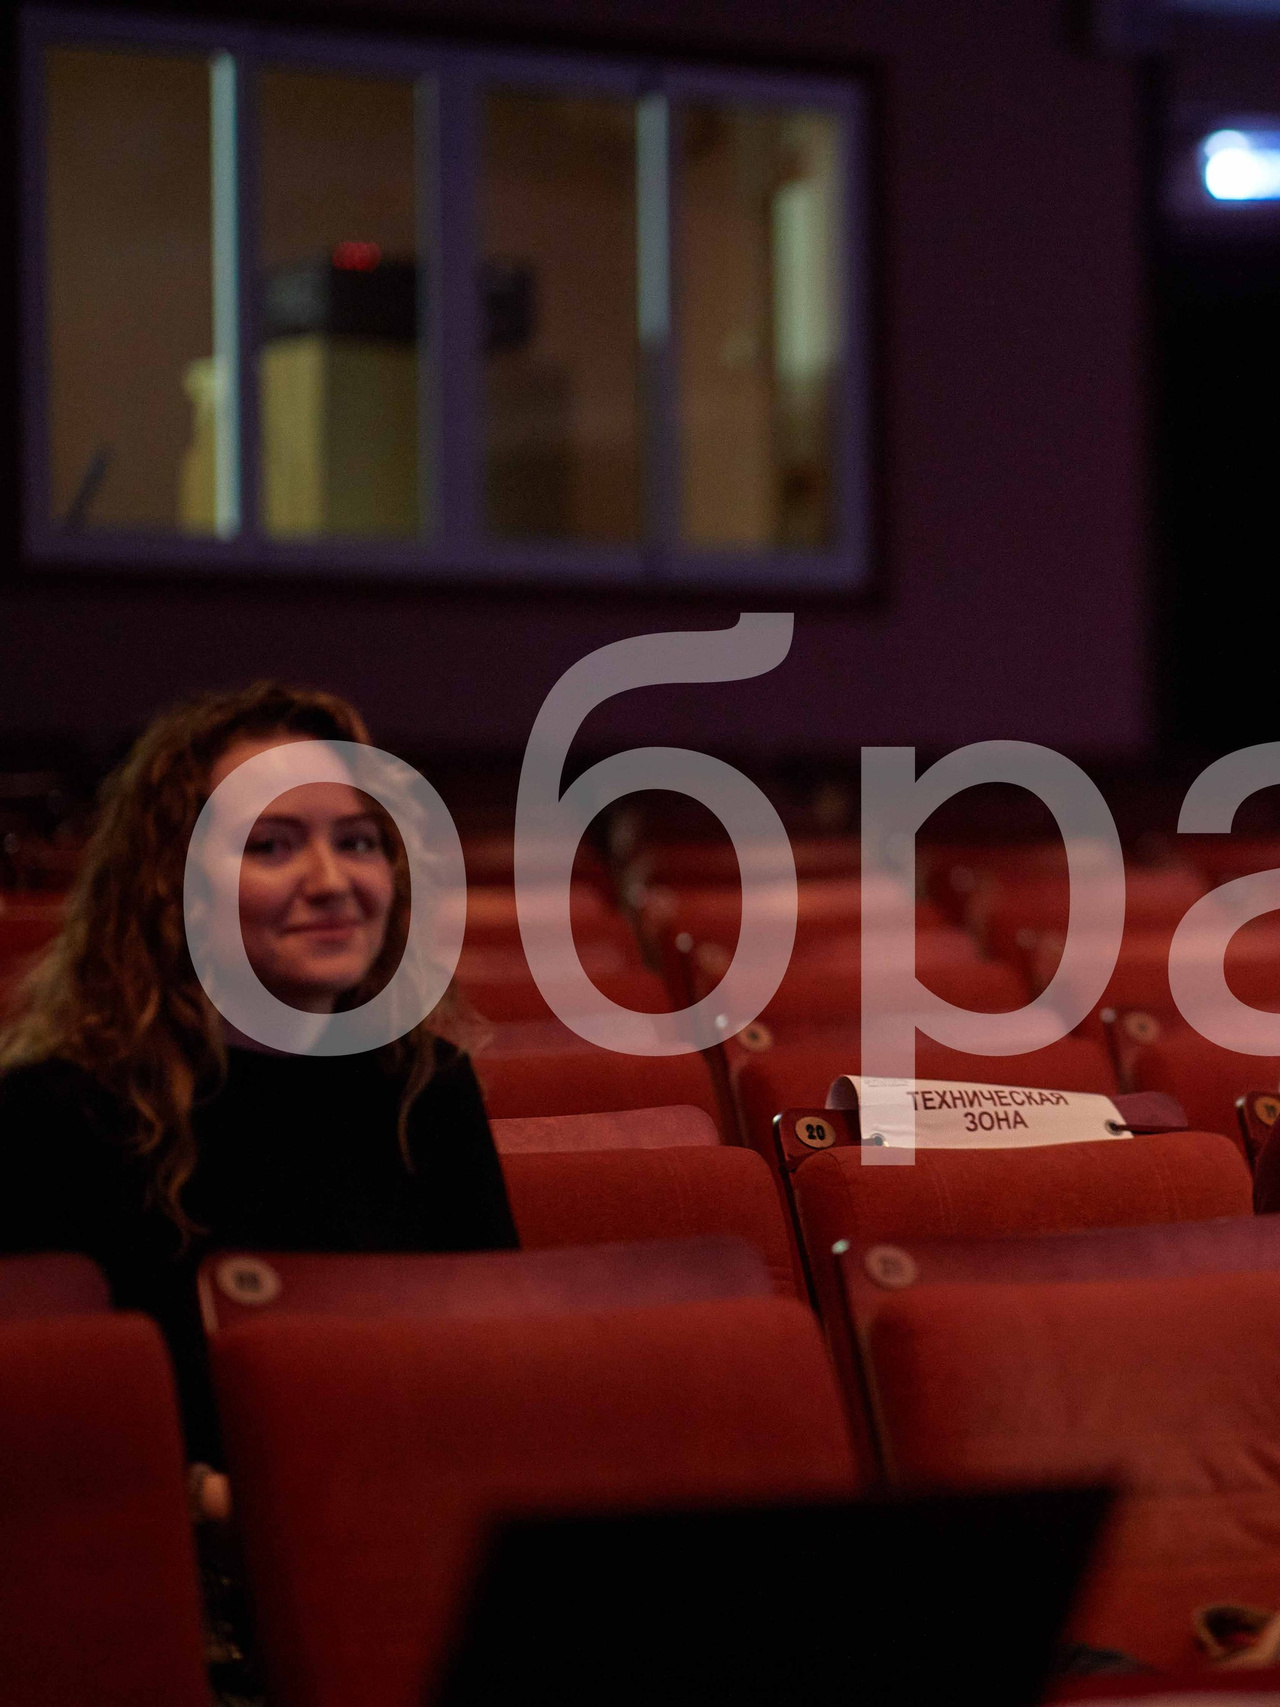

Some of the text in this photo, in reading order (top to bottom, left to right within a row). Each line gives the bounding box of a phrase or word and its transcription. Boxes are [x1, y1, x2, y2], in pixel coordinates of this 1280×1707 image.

[906, 1089, 1070, 1111] ТЕХНИЧЕСКАЯ
[805, 1123, 826, 1140] 20
[963, 1110, 1029, 1132] ЗОНА
